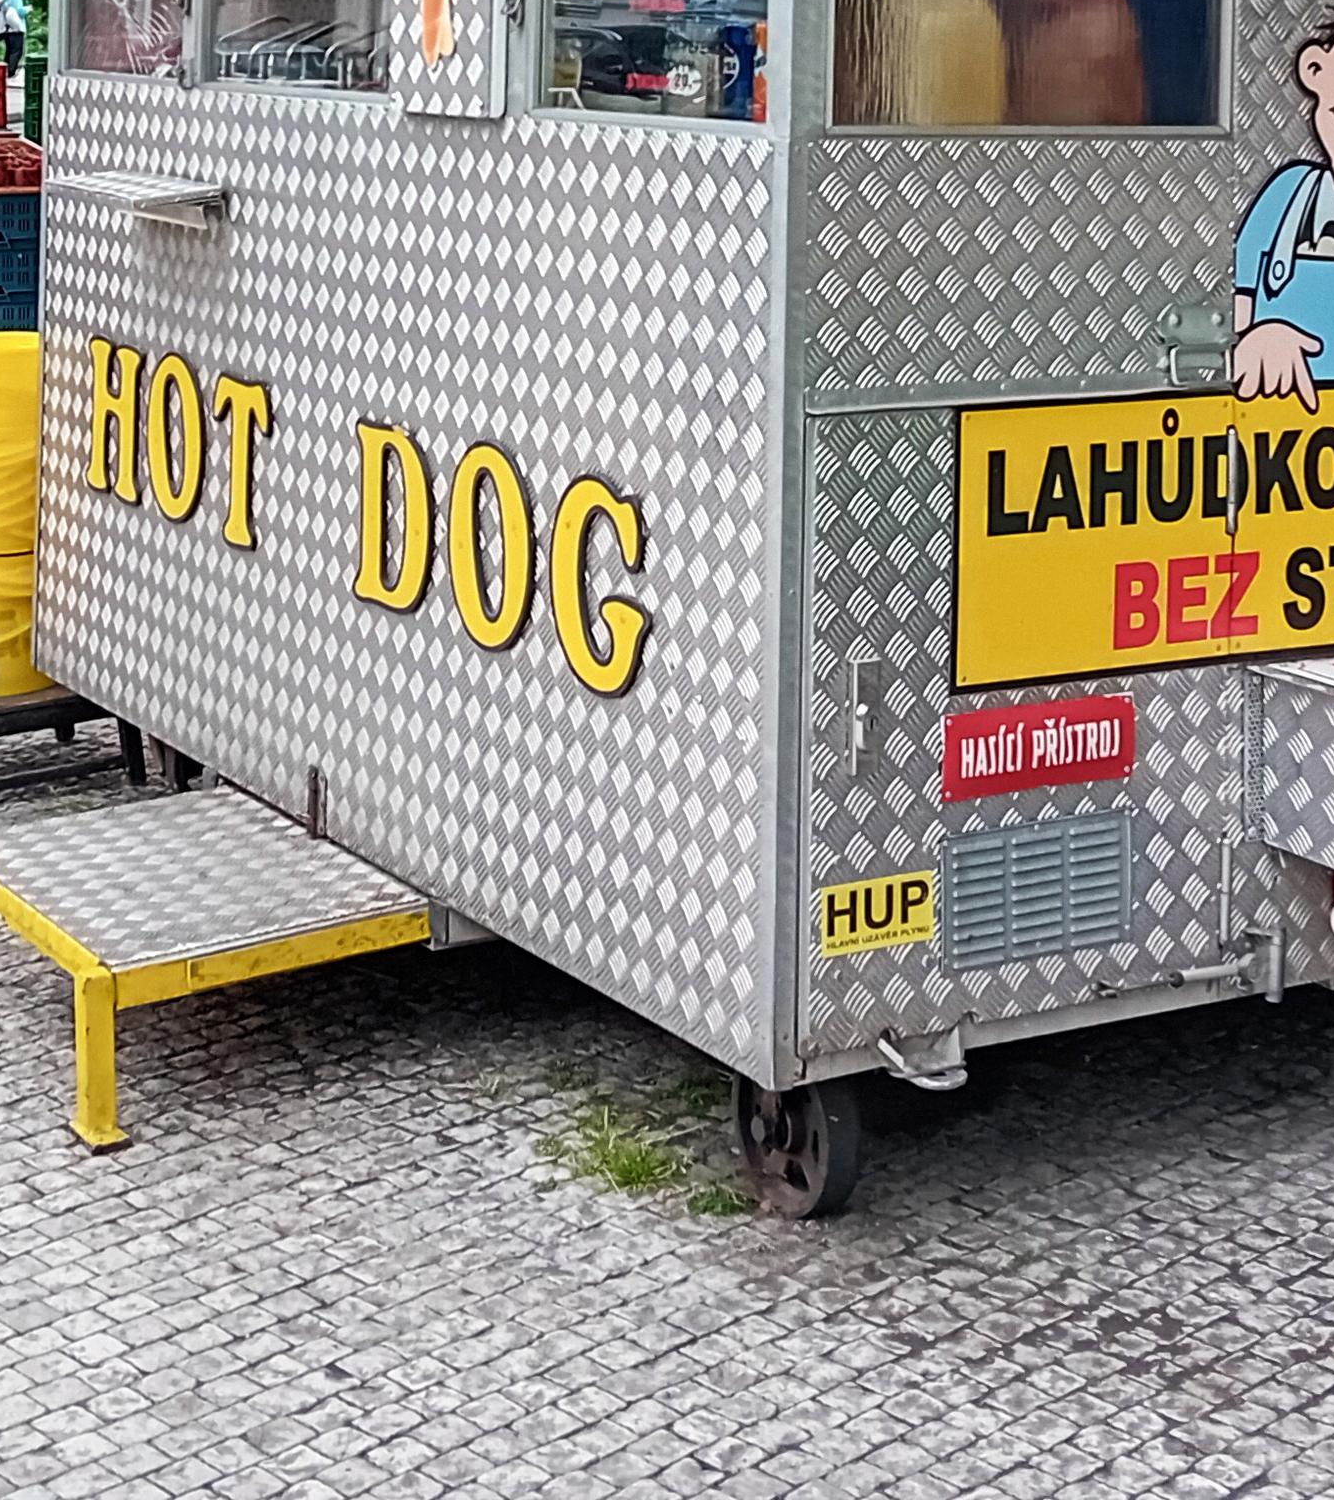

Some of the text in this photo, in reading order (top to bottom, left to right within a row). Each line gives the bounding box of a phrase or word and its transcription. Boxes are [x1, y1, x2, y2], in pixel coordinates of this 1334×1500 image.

[86, 335, 653, 699] HOT DOG
[1113, 551, 1260, 651] BEZ
[960, 716, 1120, 779] HASÍCÍ PŘÍSTROJ
[826, 937, 860, 949] HLAVNÍ
[900, 924, 930, 938] PLYNU
[827, 879, 929, 937] HUP
